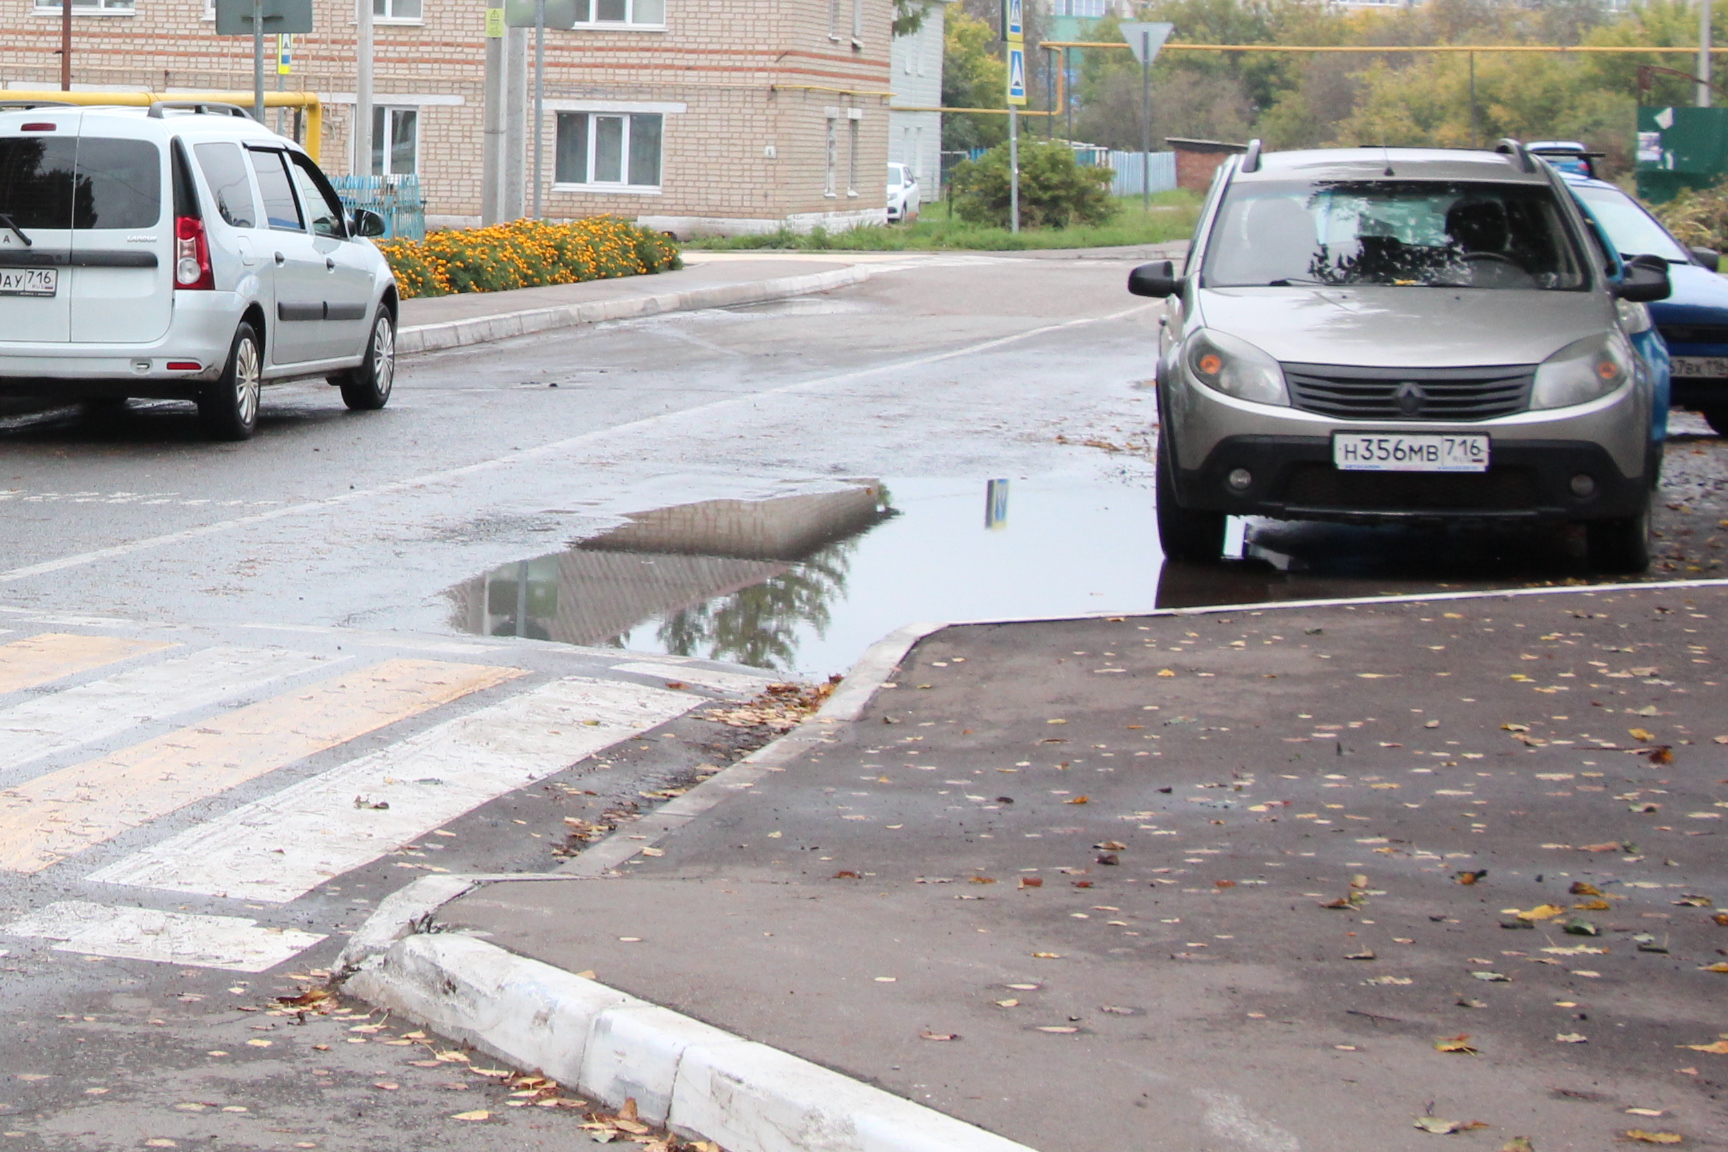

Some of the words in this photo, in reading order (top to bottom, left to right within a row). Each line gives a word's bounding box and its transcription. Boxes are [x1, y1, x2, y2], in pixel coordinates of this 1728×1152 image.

[27, 271, 51, 284] 716
[1344, 439, 1439, 462] Н356МВ
[1444, 439, 1482, 456] 716
